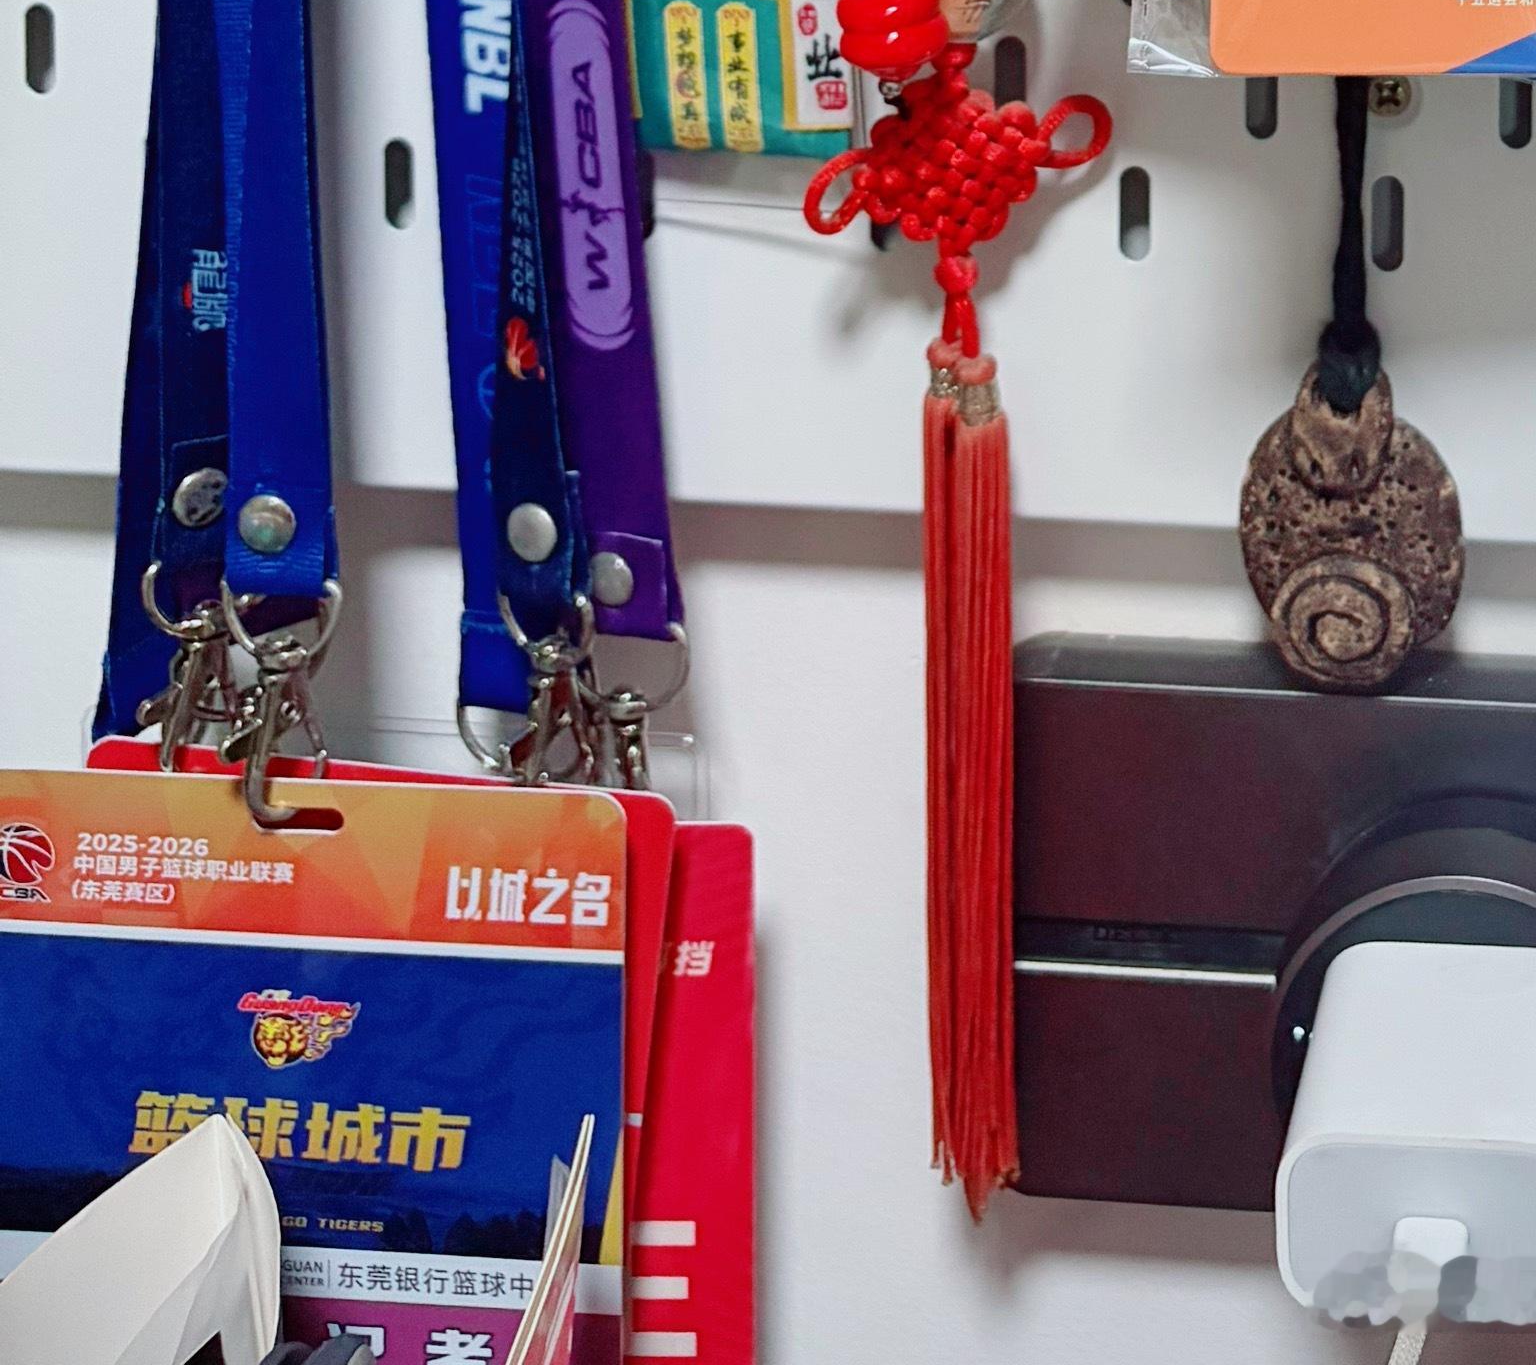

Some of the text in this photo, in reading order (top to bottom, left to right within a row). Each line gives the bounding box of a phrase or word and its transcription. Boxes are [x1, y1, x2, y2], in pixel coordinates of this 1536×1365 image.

[77, 832, 209, 857] 2025-2026
[72, 855, 295, 885] 中国男子篮球职业联赛
[70, 879, 176, 905] (东莞赛区)
[445, 865, 613, 927] 以城之名
[662, 940, 716, 977] 挡
[128, 1089, 471, 1172] 篮球城市
[317, 1217, 385, 1234] TIGERS
